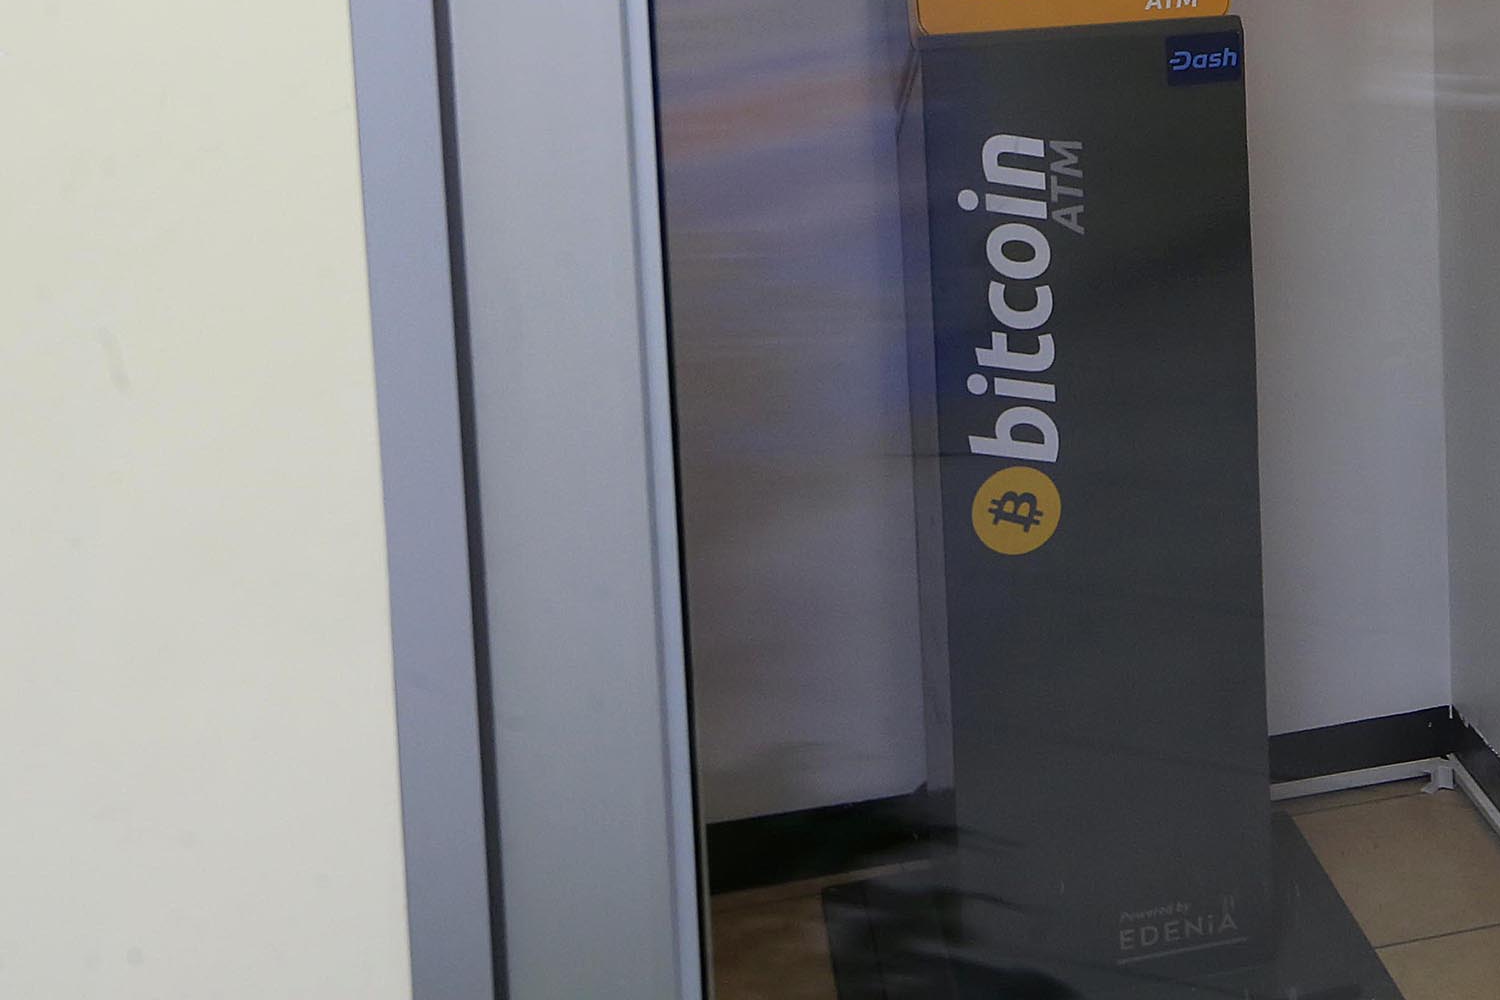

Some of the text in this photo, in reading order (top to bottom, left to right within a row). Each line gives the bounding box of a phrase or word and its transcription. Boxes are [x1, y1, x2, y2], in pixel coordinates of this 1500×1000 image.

[1169, 47, 1237, 71] Dash
[1050, 139, 1085, 235] ATM
[957, 133, 1060, 462] bitcoin
